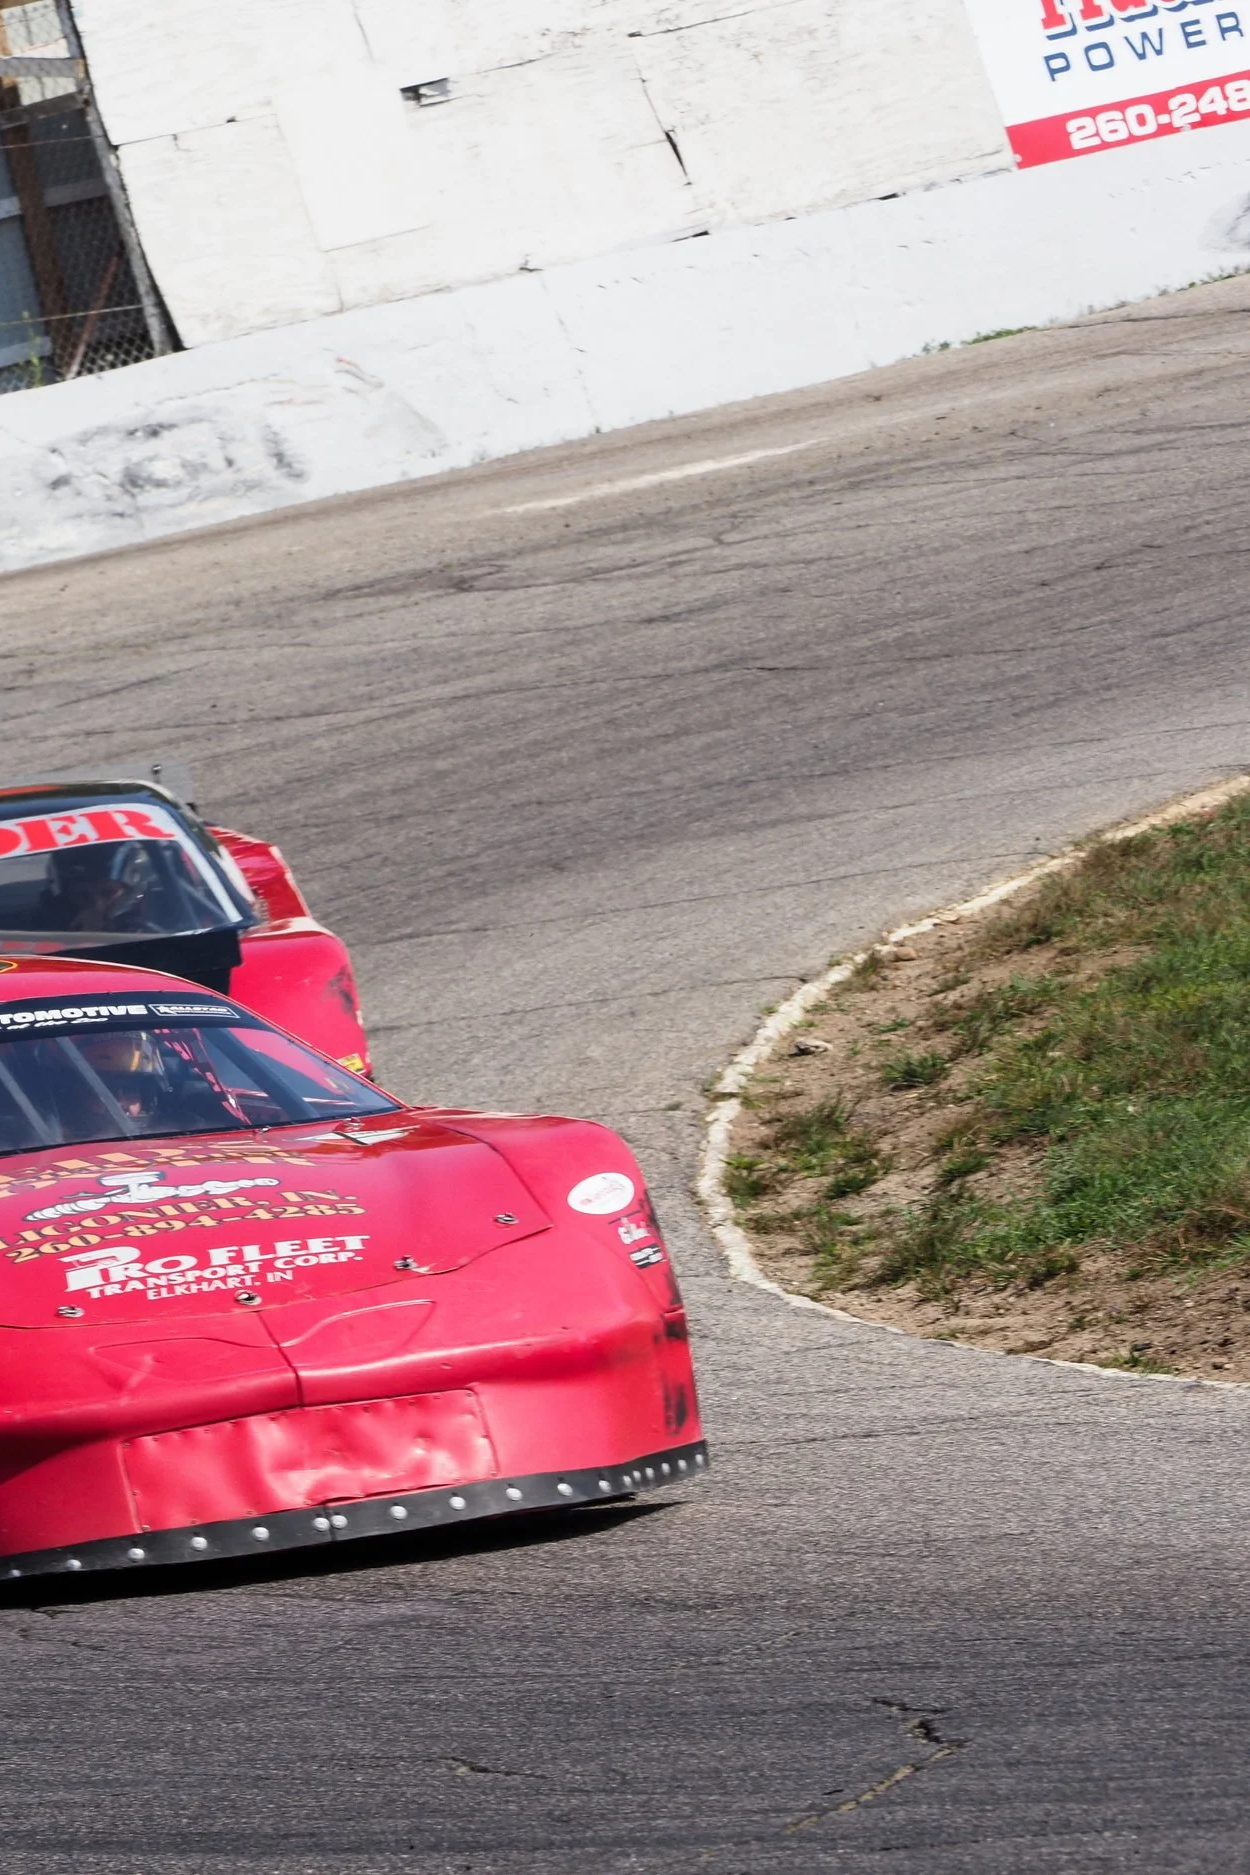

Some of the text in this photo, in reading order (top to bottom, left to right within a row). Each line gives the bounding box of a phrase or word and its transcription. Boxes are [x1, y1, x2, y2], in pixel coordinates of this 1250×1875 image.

[1043, 11, 1244, 82] POWER
[1066, 79, 1250, 150] 260-248
[4, 1203, 367, 1264] 260-894-4285
[57, 1235, 371, 1293] PRO FLEET
[85, 1251, 364, 1299] TRANSPORT CORP.
[266, 1270, 294, 1283] IN
